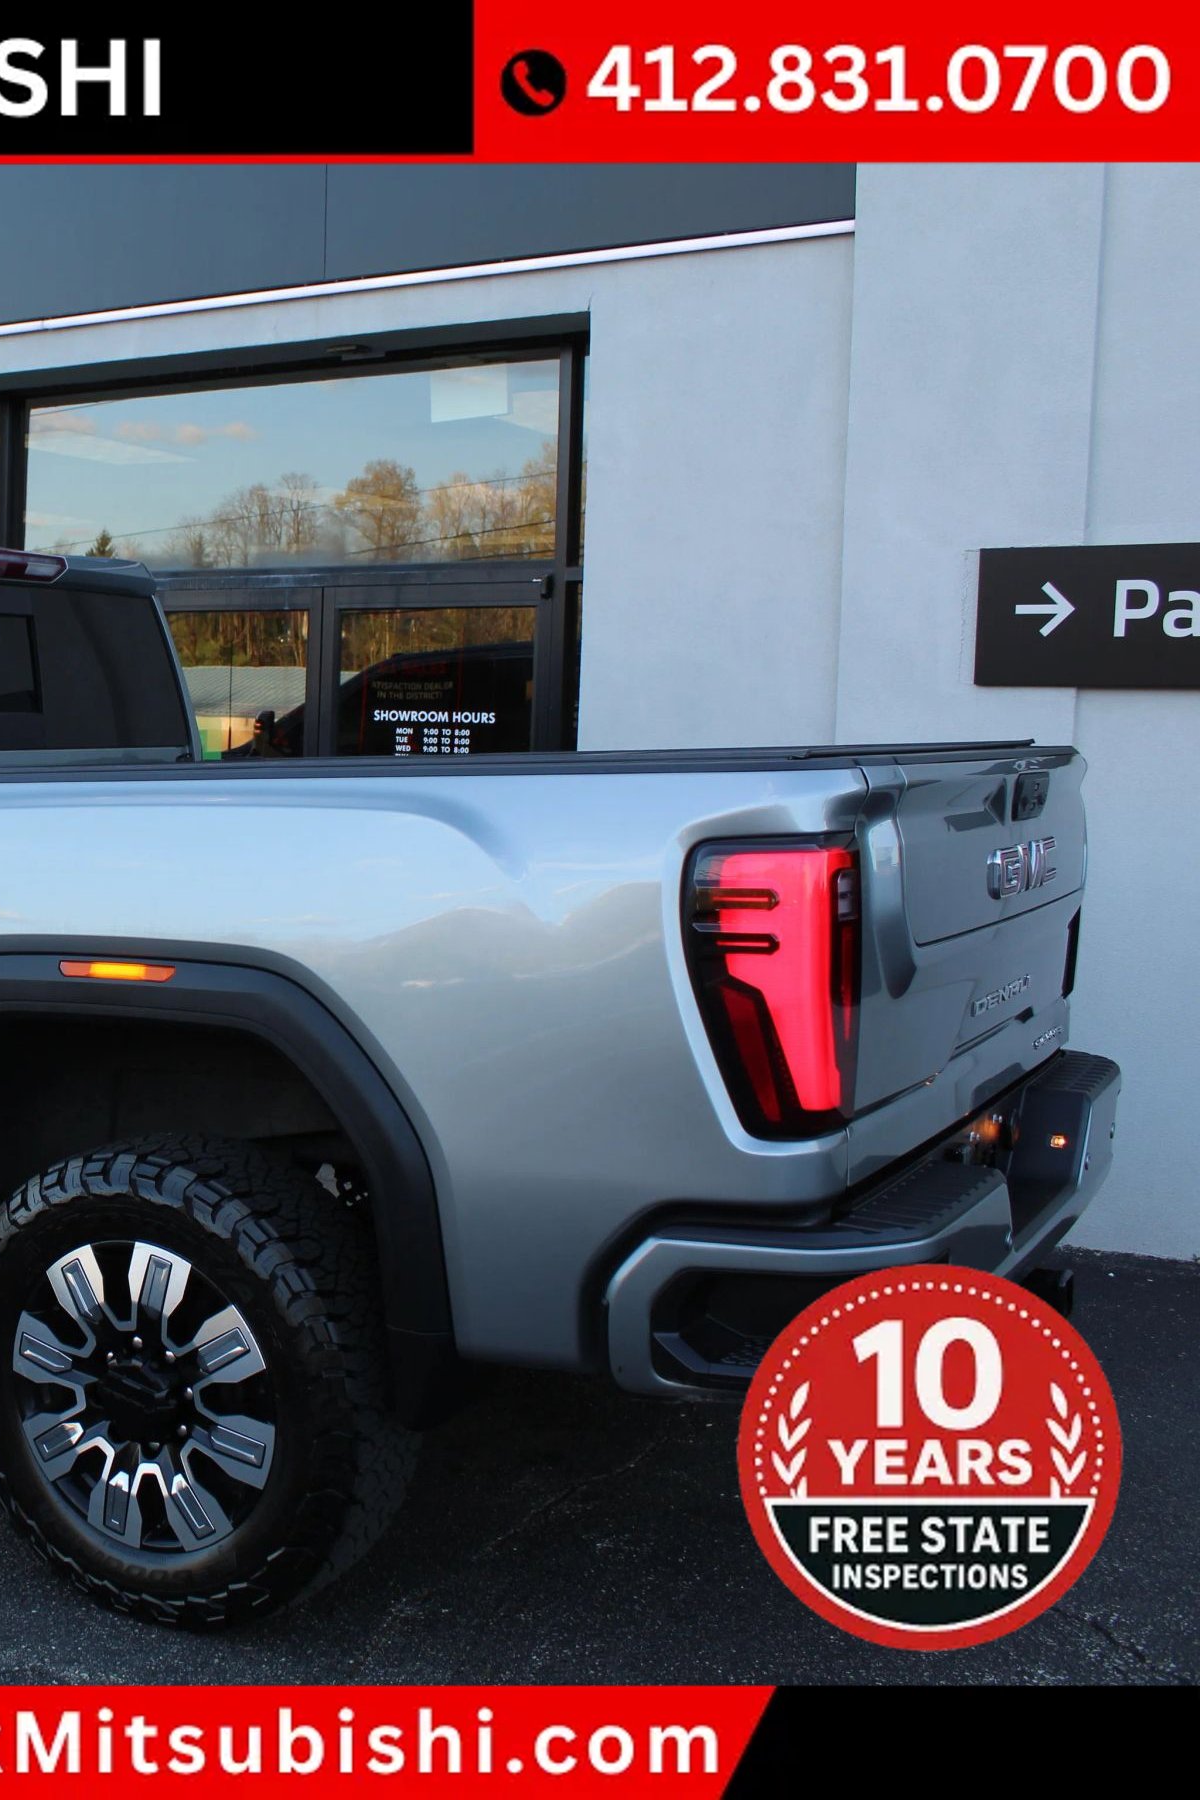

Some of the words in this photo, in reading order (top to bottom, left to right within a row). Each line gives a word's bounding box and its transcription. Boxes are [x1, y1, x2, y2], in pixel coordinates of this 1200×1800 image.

[1113, 579, 1200, 638] Pa
[373, 709, 449, 722] SHOWROOM
[452, 711, 496, 724] HOURS
[395, 727, 414, 735] MON
[441, 728, 452, 736] TO
[395, 744, 412, 752] WED
[987, 836, 1057, 899] GMC
